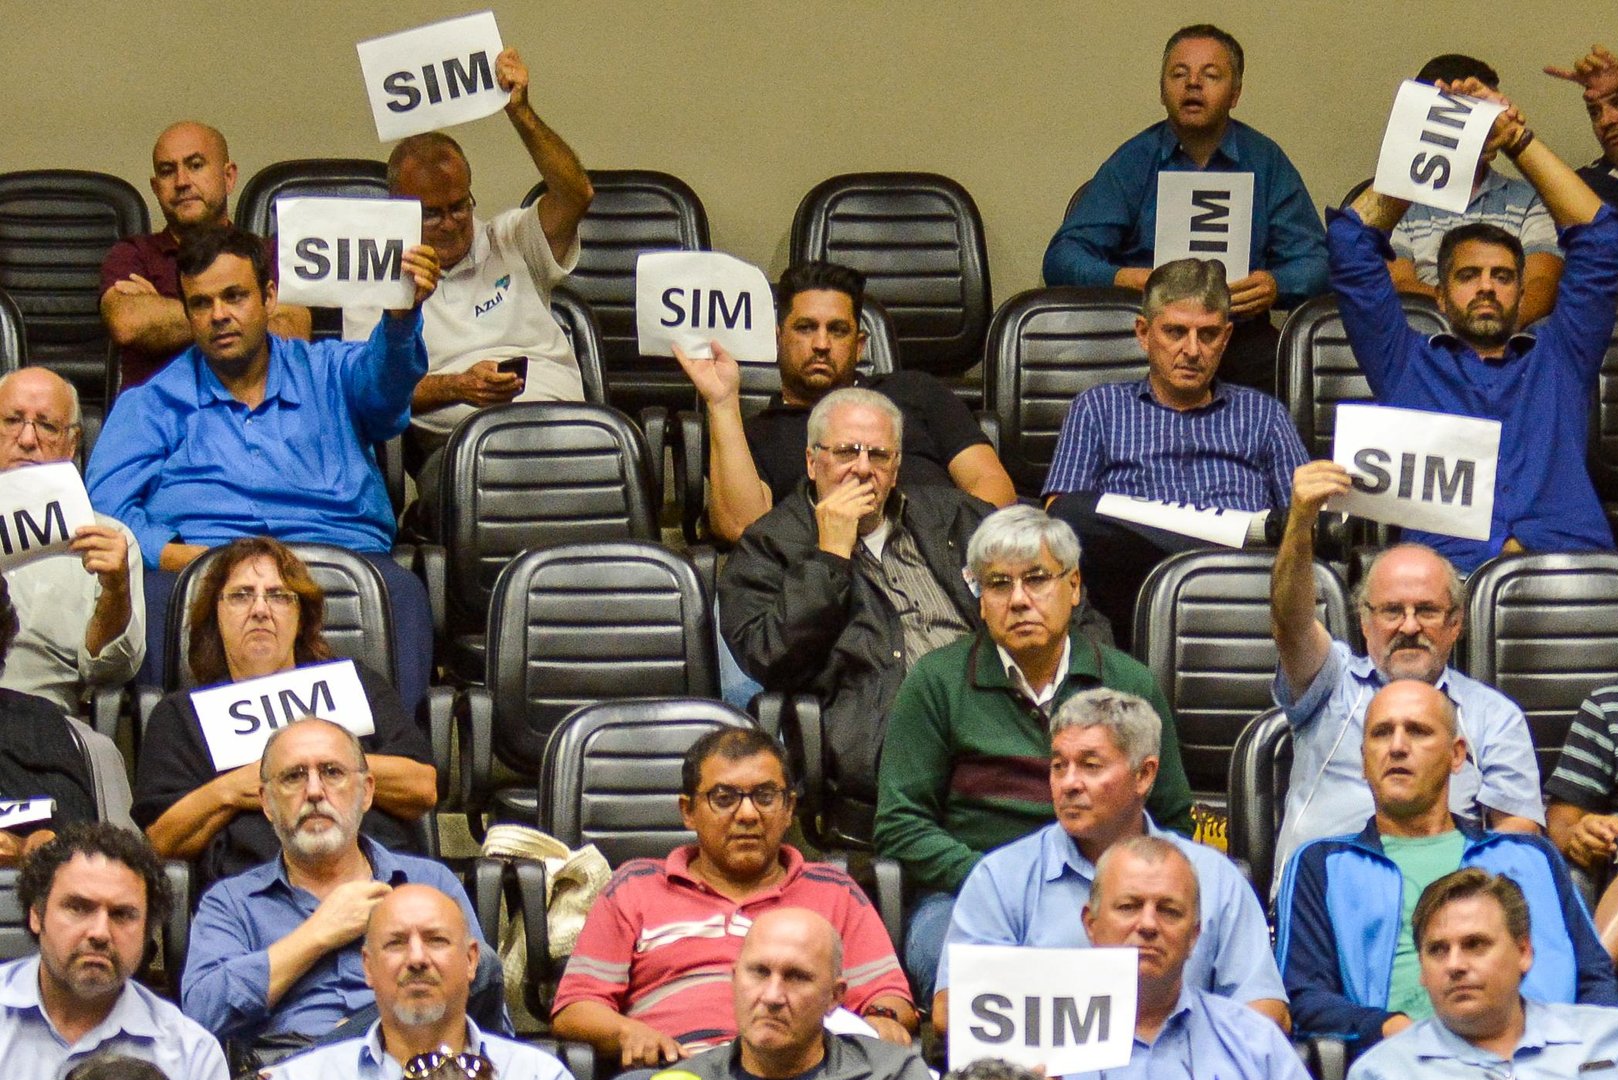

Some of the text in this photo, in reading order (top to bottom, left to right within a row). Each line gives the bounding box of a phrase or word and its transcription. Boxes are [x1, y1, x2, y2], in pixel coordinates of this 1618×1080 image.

[384, 51, 495, 113] SIM
[1189, 190, 1231, 253] IM
[294, 238, 402, 283] SIM
[475, 291, 503, 317] Azul
[661, 288, 751, 329] SIM
[1352, 449, 1475, 506] SIM
[0, 501, 70, 555] IM
[229, 680, 336, 735] SIM
[970, 993, 1111, 1047] SIM
